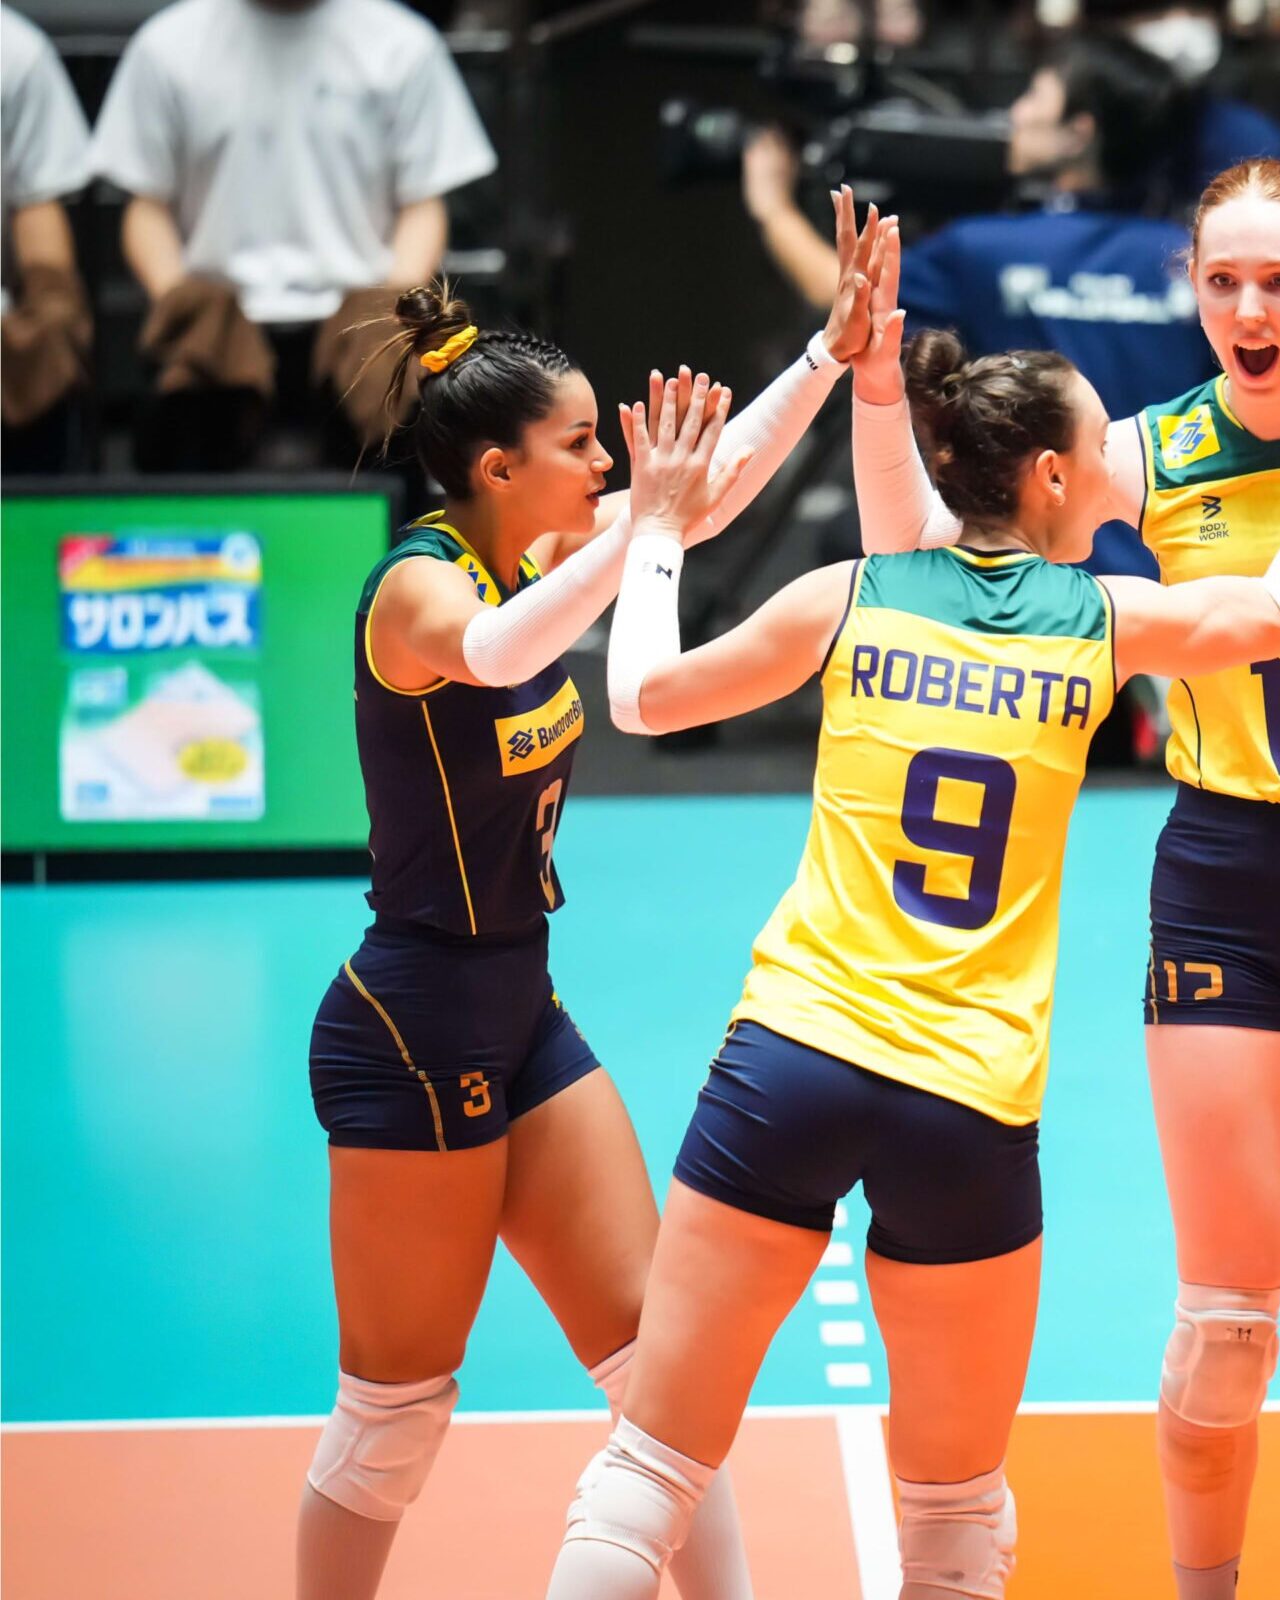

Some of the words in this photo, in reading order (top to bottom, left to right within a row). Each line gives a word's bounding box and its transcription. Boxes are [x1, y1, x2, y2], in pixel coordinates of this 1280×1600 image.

[1199, 530, 1229, 541] WORK
[1200, 522, 1227, 534] BODY
[851, 645, 1092, 730] ROBERTA
[536, 779, 562, 909] 3
[893, 747, 1017, 930] 9
[460, 1071, 491, 1118] 3
